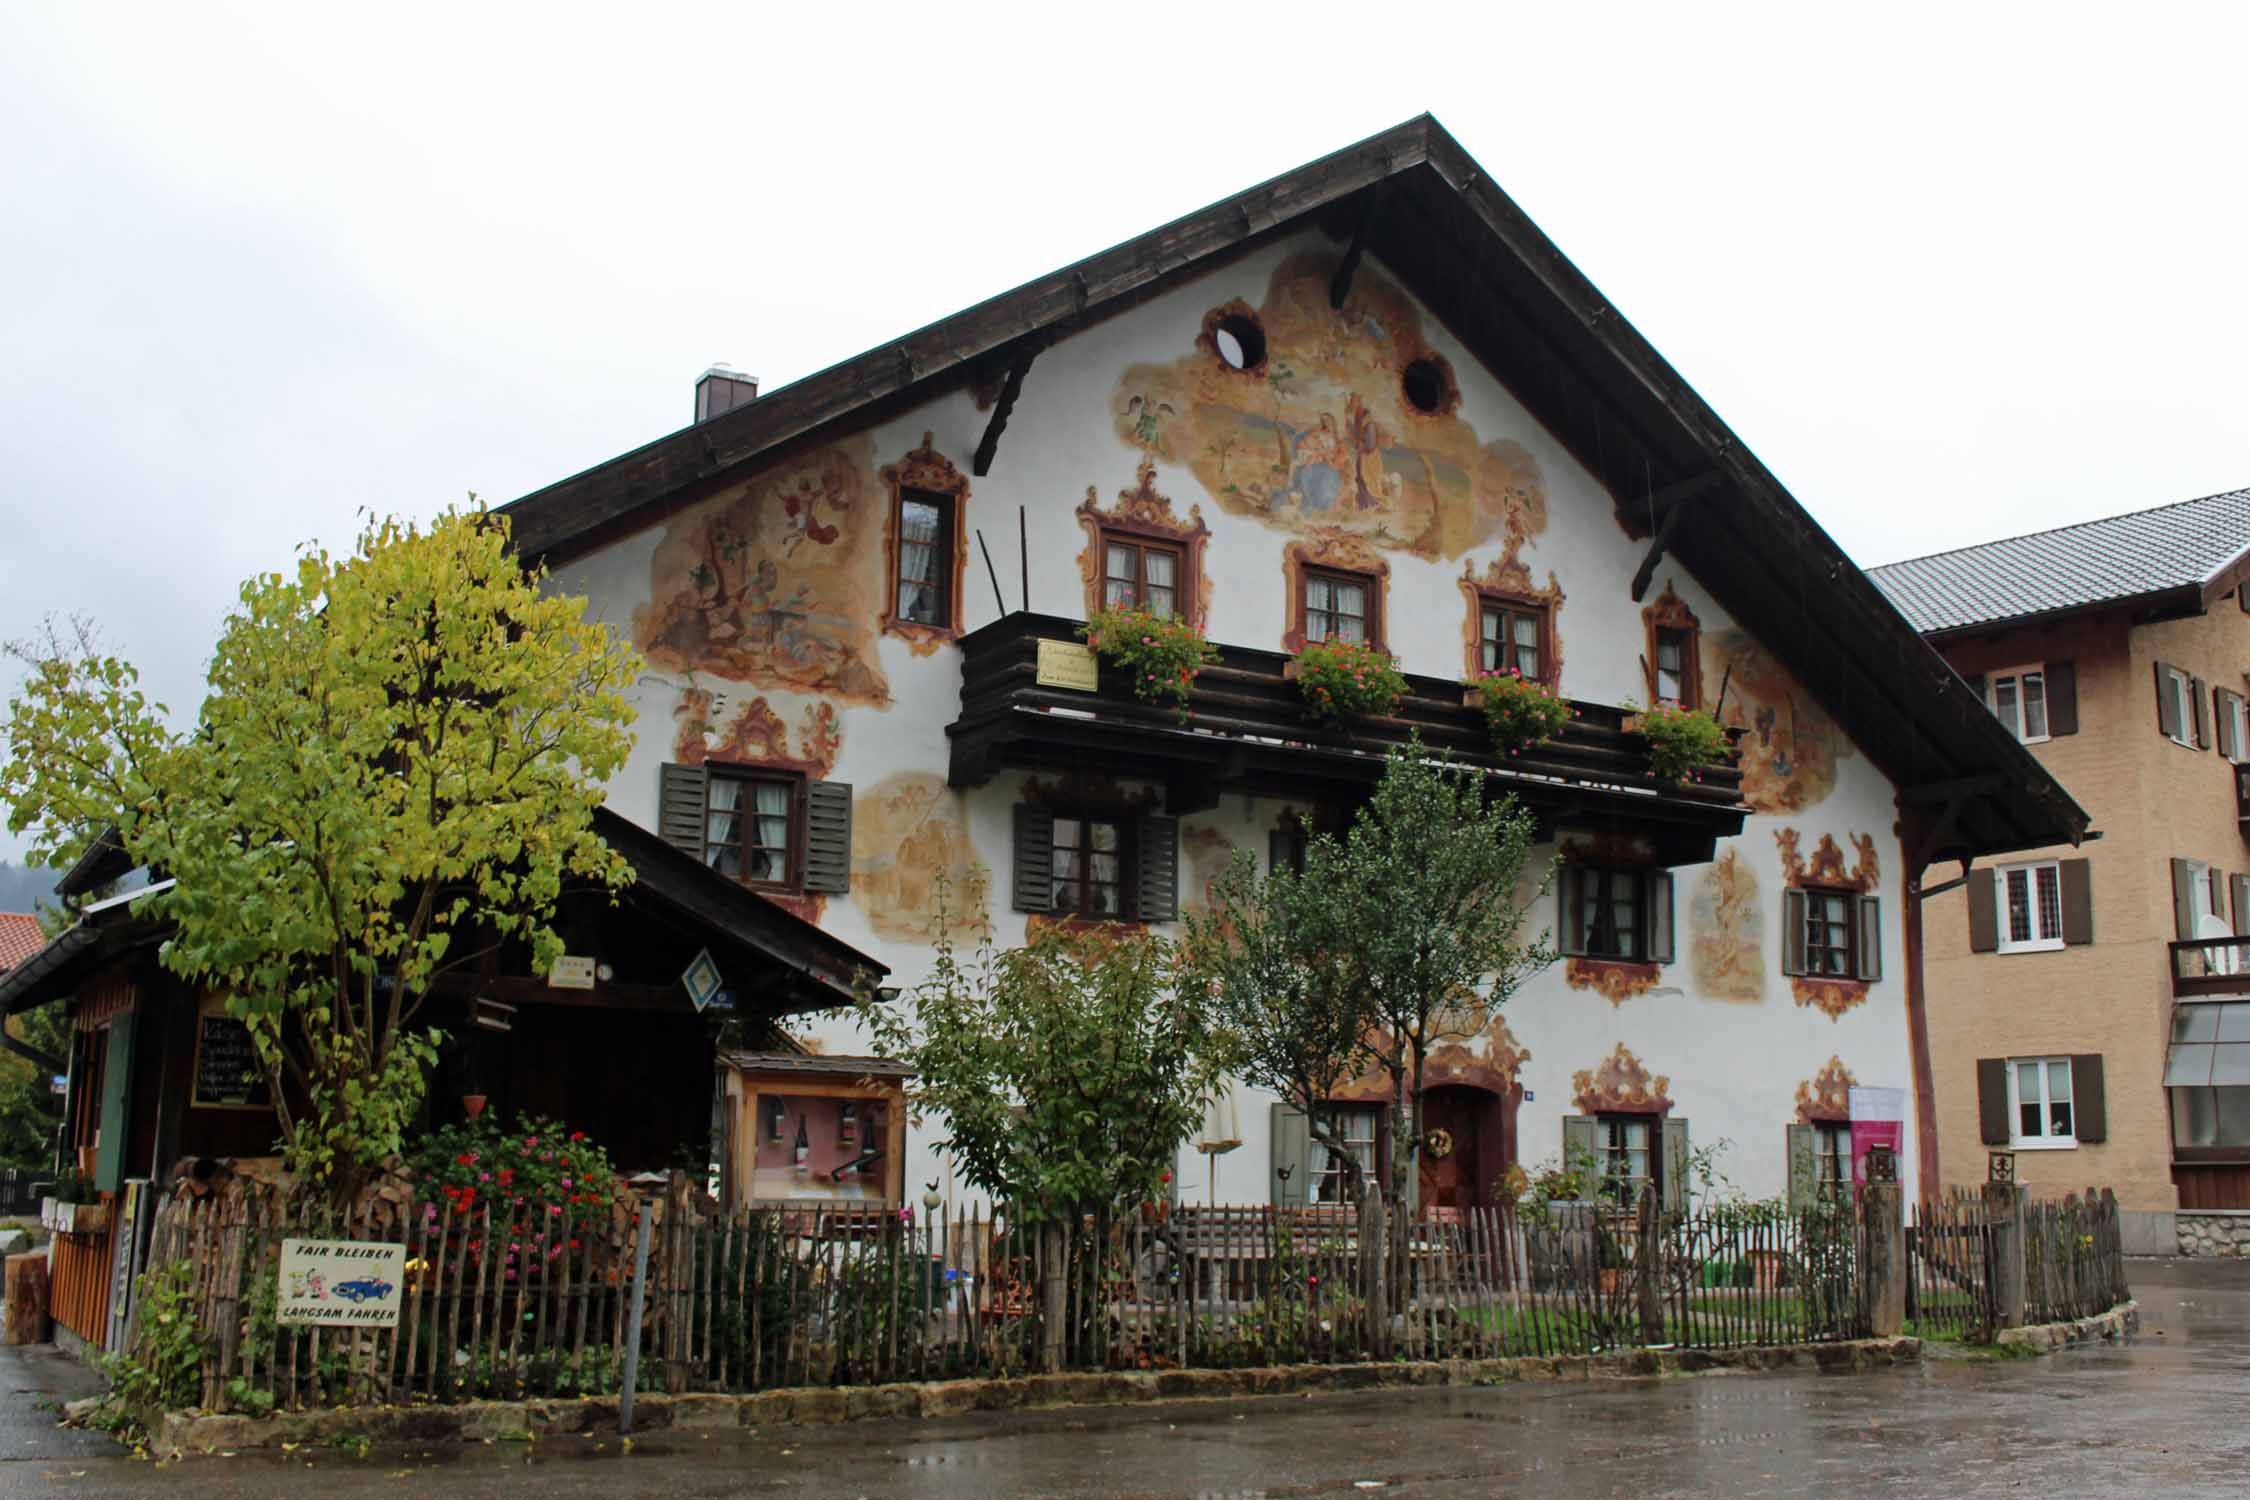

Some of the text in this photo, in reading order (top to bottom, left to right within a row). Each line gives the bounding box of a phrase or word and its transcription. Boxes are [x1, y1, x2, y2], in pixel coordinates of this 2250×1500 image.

[296, 1246, 395, 1259] FAIR BLEIBEN
[283, 1307, 396, 1320] LANGSAM FAHREN
